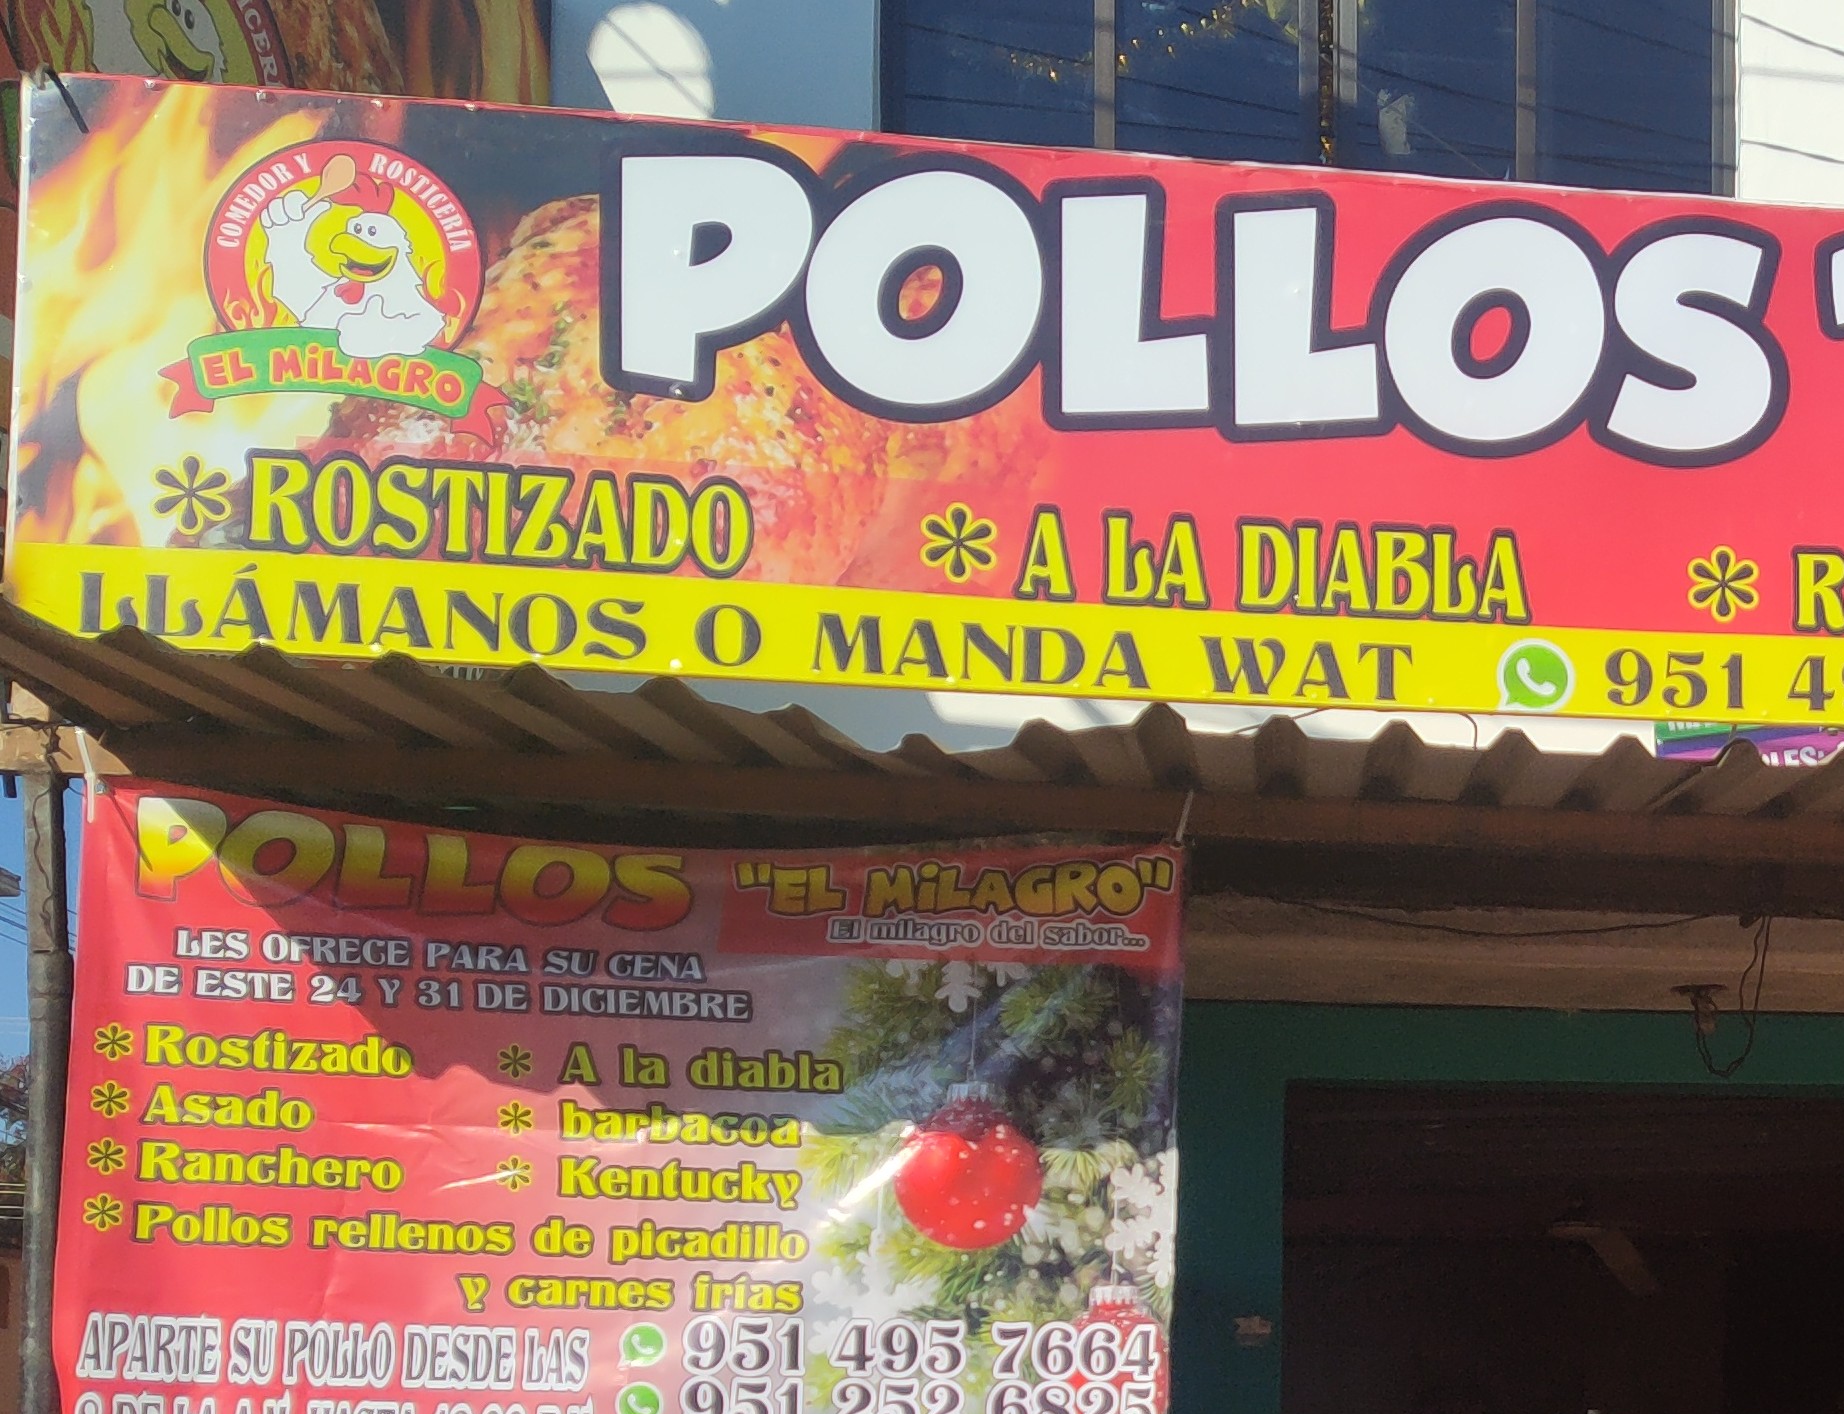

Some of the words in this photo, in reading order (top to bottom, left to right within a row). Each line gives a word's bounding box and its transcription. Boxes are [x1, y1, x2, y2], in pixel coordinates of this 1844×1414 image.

[215, 162, 292, 250] COMEDOR
[293, 154, 311, 178] Y
[369, 152, 469, 253] ROSTICERÍA
[612, 145, 1780, 460] POLLOS
[202, 353, 252, 390] EL
[248, 451, 753, 577] ROSTIZADO
[1016, 505, 1075, 600] A
[1103, 510, 1208, 608] LA
[1236, 518, 1532, 623] DIABLA
[78, 562, 648, 661] LLÁMANOS
[694, 603, 762, 667] O
[811, 612, 1152, 691] MANDA
[1202, 635, 1414, 702] WAT
[1603, 647, 1746, 711] 951
[136, 797, 692, 931] POLLOS
[175, 928, 250, 962] LES
[262, 932, 411, 967] OFRECE
[426, 941, 529, 974] PARA
[543, 947, 597, 976] SU
[609, 952, 706, 982] CENA
[125, 965, 181, 995] DE
[195, 967, 294, 1002] ESTE
[310, 974, 362, 1004] 24
[379, 978, 401, 1004] Y
[418, 980, 461, 1009] 31
[477, 982, 529, 1012] DE
[541, 984, 751, 1020] DICIEMBRE
[144, 1022, 414, 1078] Rostizado
[561, 1044, 600, 1084] A
[619, 1045, 670, 1087] la
[688, 1048, 844, 1093] diabla
[142, 1082, 315, 1132] Asado
[561, 1101, 802, 1148] barbacoa
[137, 1141, 405, 1192] Ranchero
[558, 1156, 802, 1209] Kentucky
[132, 1203, 292, 1246] Pollos
[311, 1210, 515, 1255] rellenos
[532, 1218, 594, 1257] de
[609, 1220, 808, 1264] picadillo
[77, 1313, 222, 1381] APARTE
[228, 1320, 278, 1383] SU
[284, 1321, 396, 1388] POLLO
[402, 1326, 516, 1391] DESDE
[524, 1328, 590, 1392] LAS
[682, 1316, 804, 1377] 951
[829, 1319, 966, 1378] 495
[991, 1322, 1161, 1382] 7664
